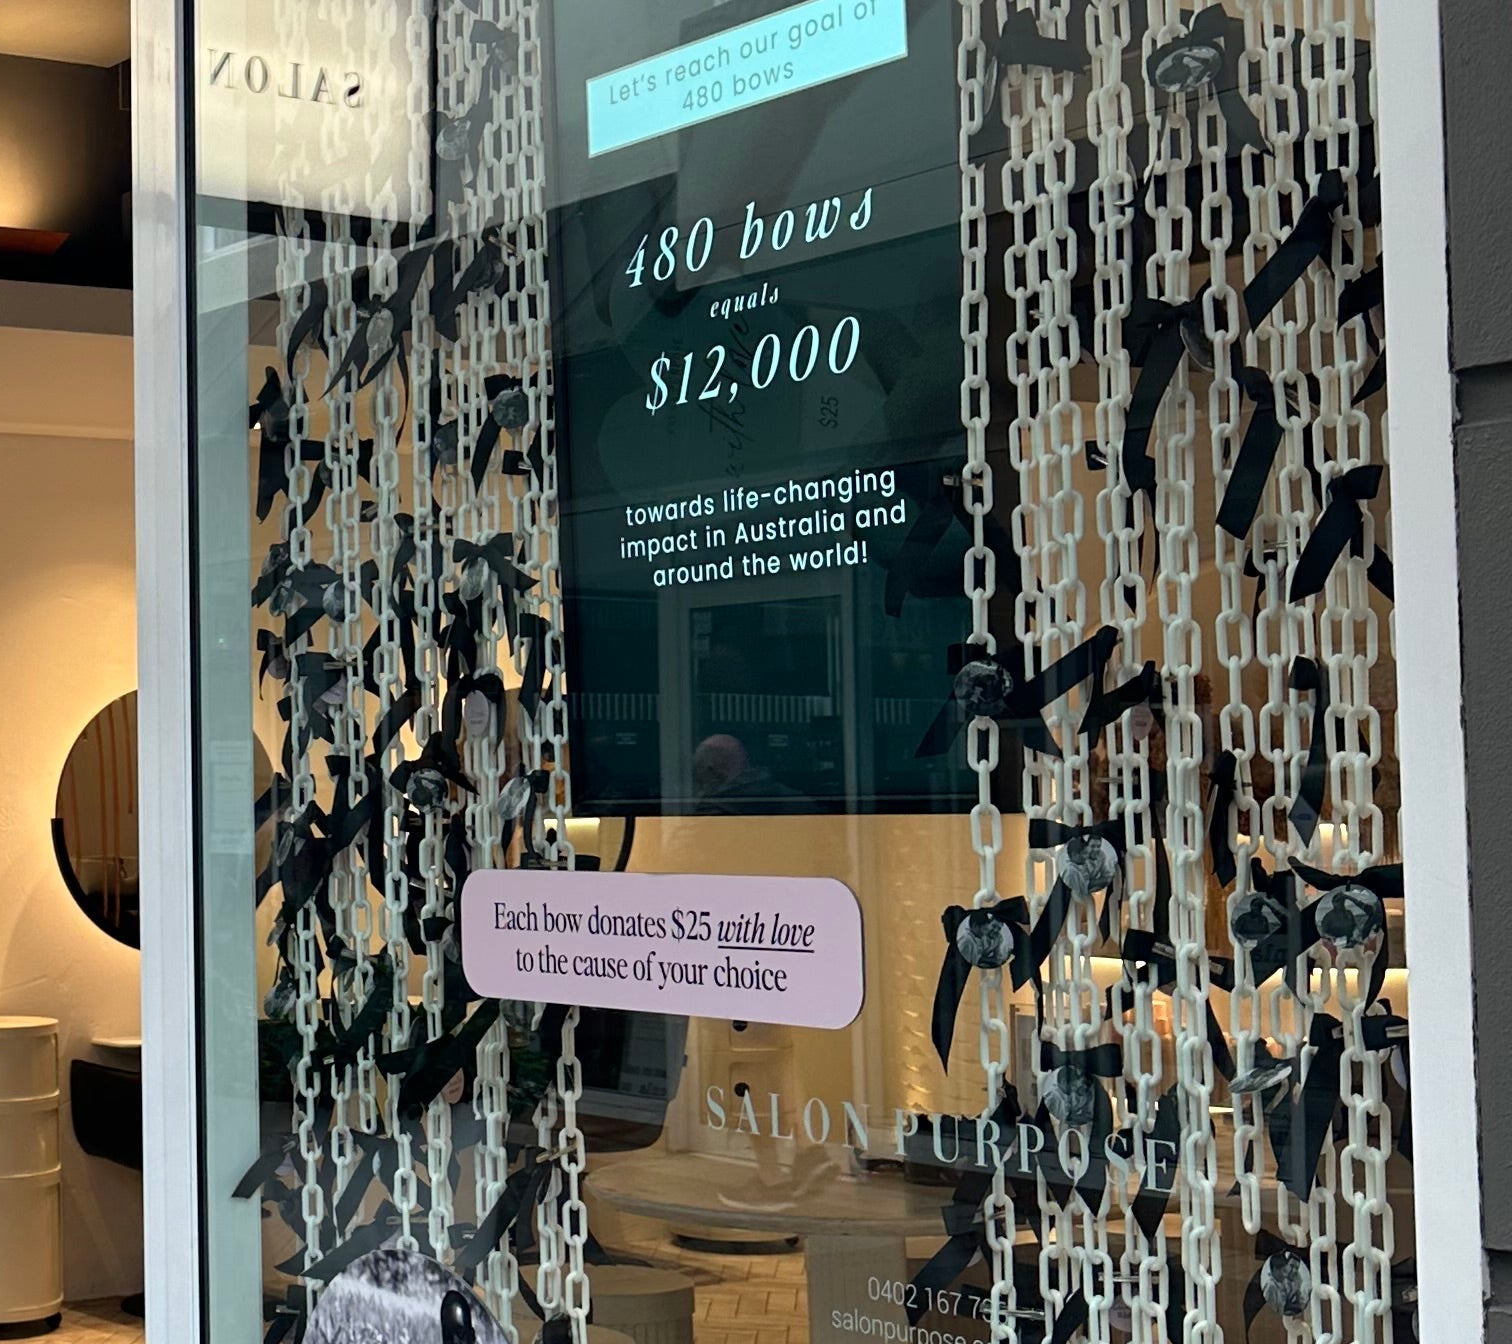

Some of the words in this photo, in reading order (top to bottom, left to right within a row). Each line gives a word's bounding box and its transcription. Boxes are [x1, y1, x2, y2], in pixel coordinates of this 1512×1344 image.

[665, 45, 731, 86] reach
[739, 30, 779, 60] our
[787, 10, 843, 51] goal
[682, 81, 724, 112] 480
[732, 60, 795, 96] bows
[625, 216, 714, 288] 480
[739, 187, 873, 259] bows
[709, 282, 779, 319] equals
[645, 316, 861, 416] $12,000
[625, 494, 715, 526] towards
[723, 469, 896, 513] life-changing
[620, 532, 697, 562] impact
[705, 525, 726, 549] in
[734, 509, 845, 545] Australia
[855, 499, 906, 529] and
[653, 556, 733, 587] around
[742, 553, 781, 577] the
[789, 540, 868, 572] world!
[494, 901, 538, 933] Each
[542, 902, 583, 935] bow
[587, 904, 667, 940] donates
[671, 906, 712, 944] $25
[717, 912, 765, 946] with
[770, 912, 816, 949] love
[516, 948, 534, 974] to
[538, 944, 569, 975] the
[572, 954, 629, 981] cause
[633, 950, 658, 982] of
[658, 959, 709, 991] your
[713, 956, 788, 993] choice
[705, 1083, 870, 1151] SALON
[894, 1107, 1178, 1194] PURPOSE
[867, 1276, 919, 1309] 0402
[924, 1287, 962, 1317] 167
